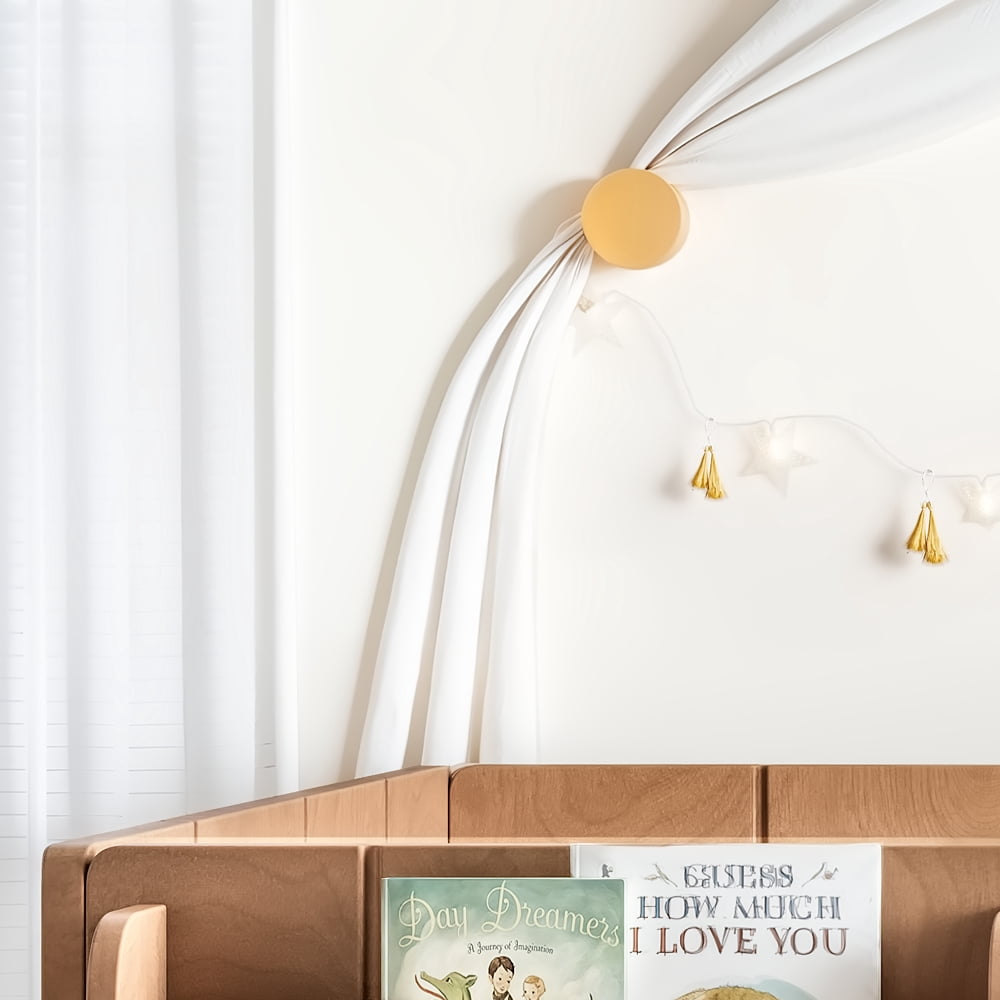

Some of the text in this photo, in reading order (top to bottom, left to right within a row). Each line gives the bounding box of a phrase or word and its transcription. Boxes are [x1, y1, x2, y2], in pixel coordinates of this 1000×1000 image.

[398, 880, 620, 948] Day Dreamers
[636, 895, 841, 920] HOW MUCH
[477, 941, 503, 954] Journey
[504, 940, 513, 950] of
[514, 939, 554, 954] Imagination
[630, 926, 849, 955] I LOVE YOU
